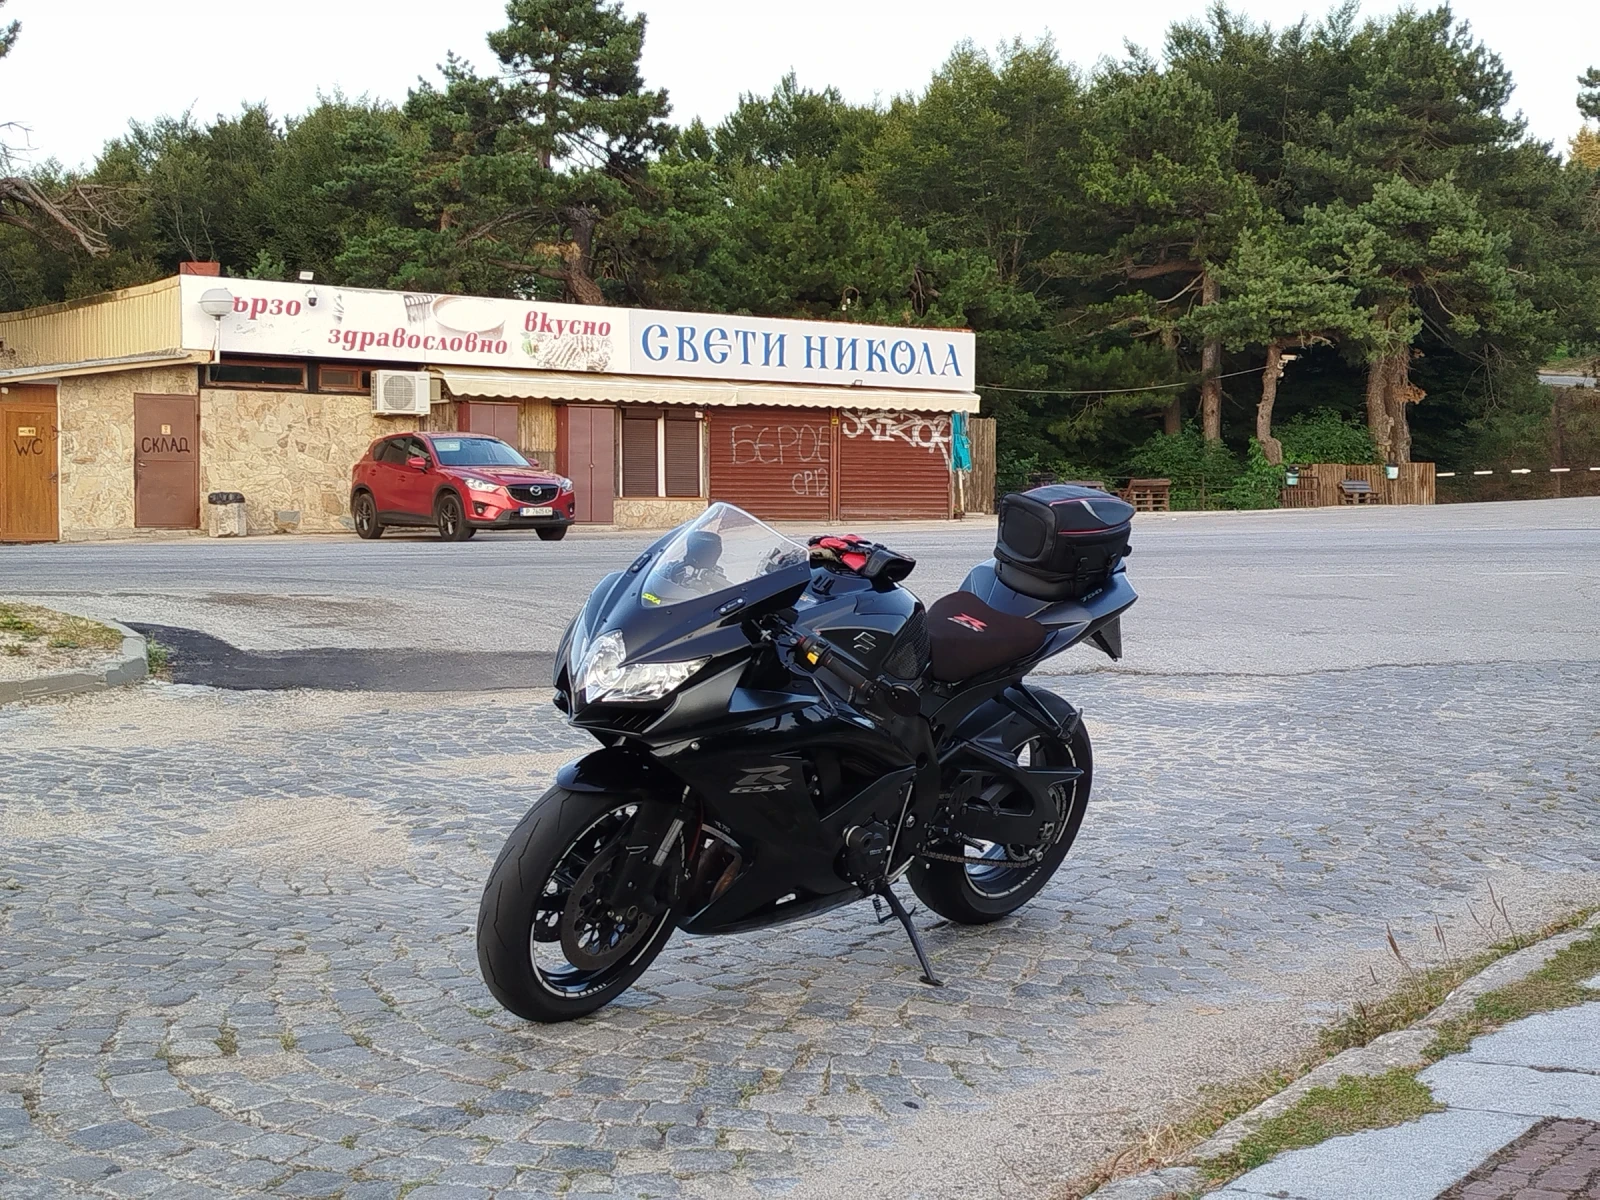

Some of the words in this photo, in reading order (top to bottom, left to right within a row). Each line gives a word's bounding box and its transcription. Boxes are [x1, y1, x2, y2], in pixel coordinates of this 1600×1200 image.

[232, 296, 302, 321] ързо
[524, 310, 612, 340] вкусно
[327, 327, 508, 355] здравословно
[641, 323, 789, 368] СВЕТИ
[802, 334, 964, 378] НИКОЛА
[13, 438, 44, 457] WC
[141, 436, 191, 454] СКЛАД
